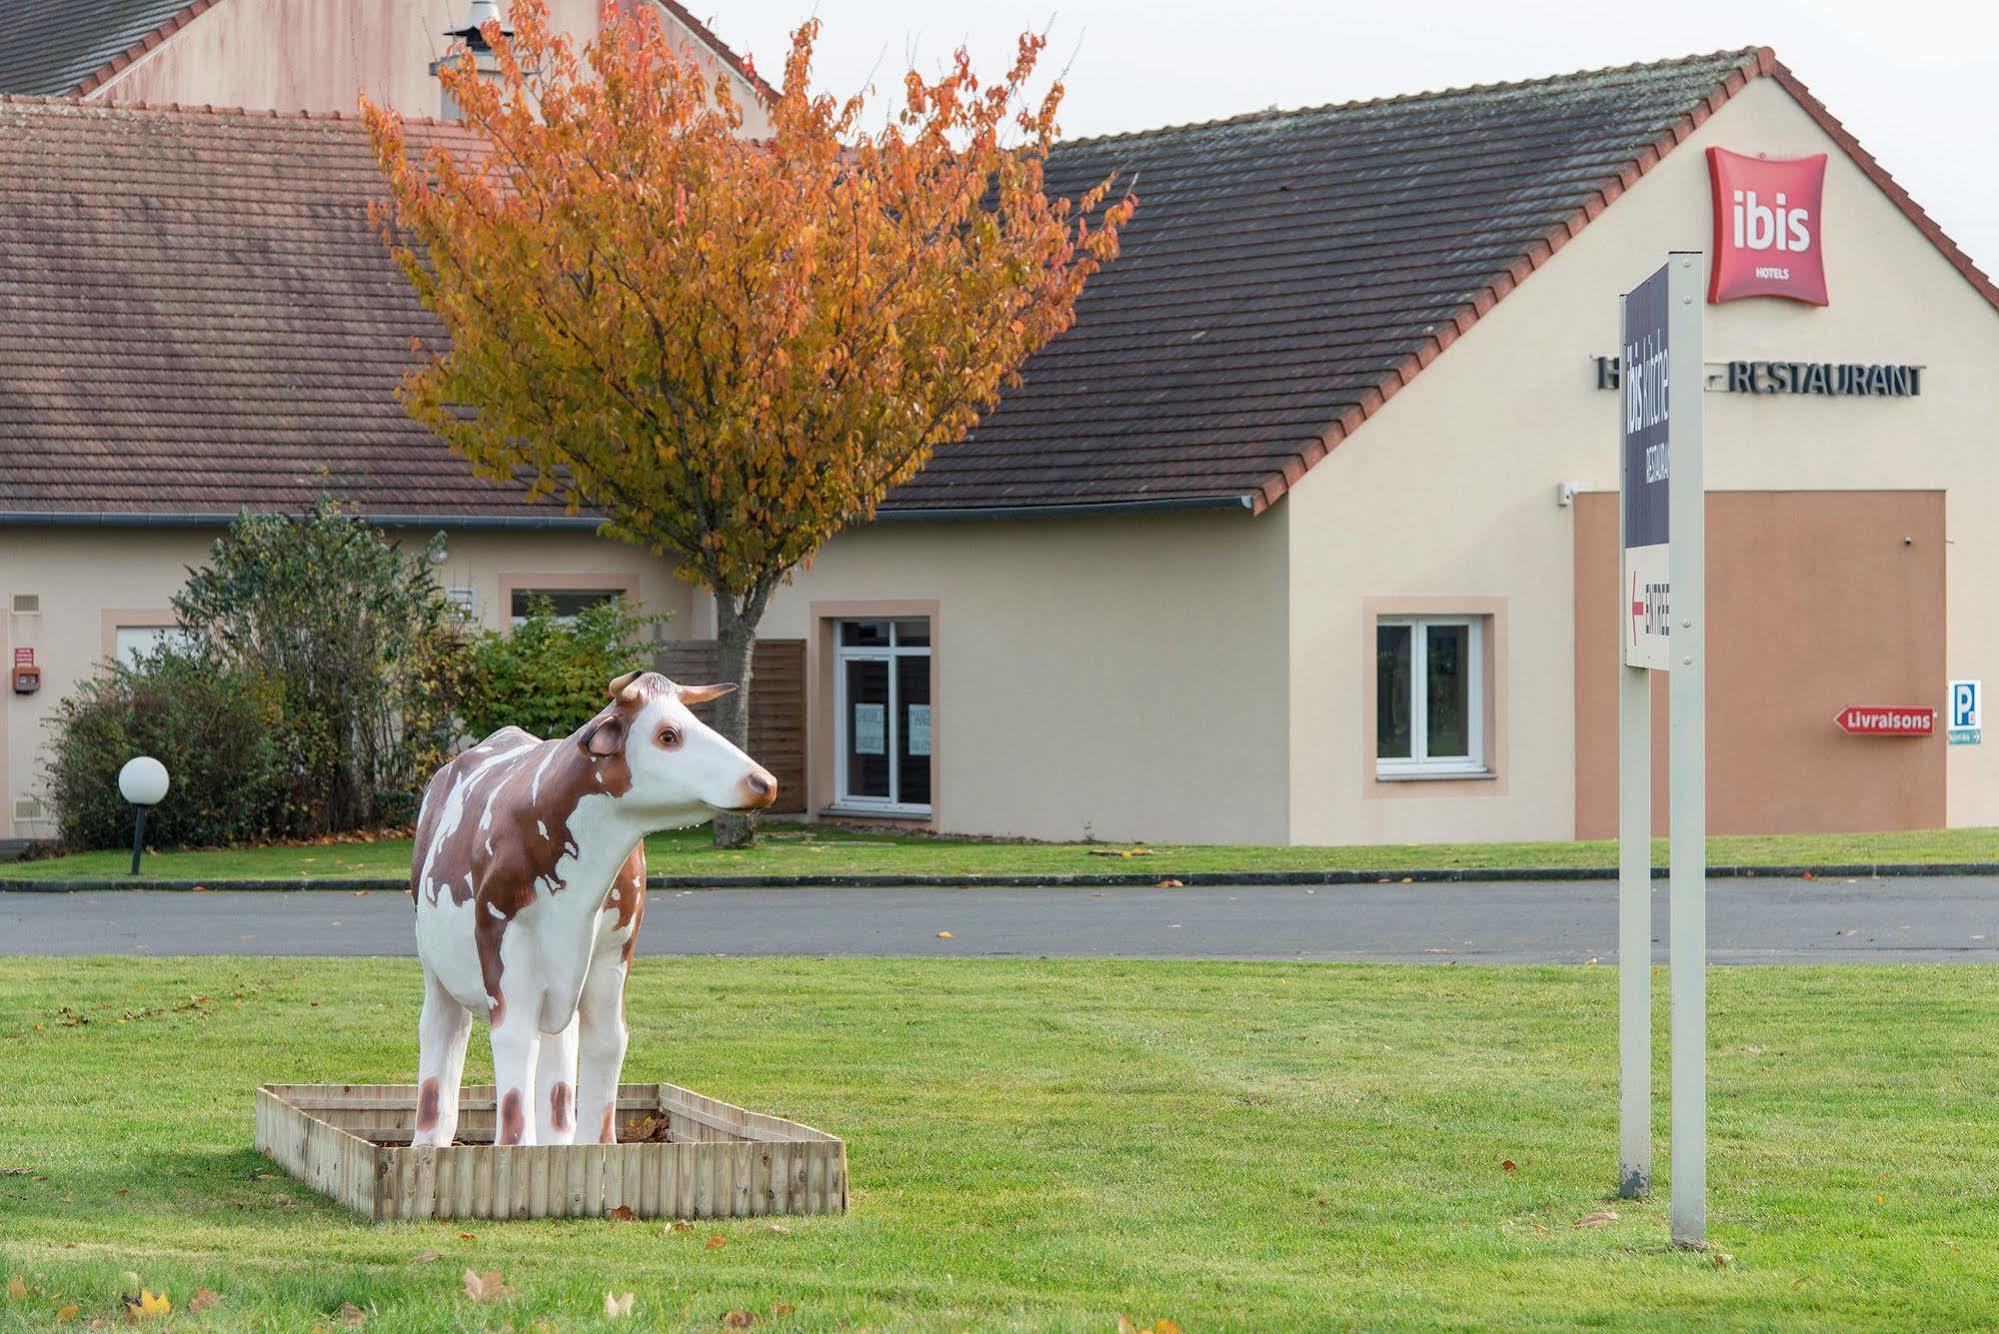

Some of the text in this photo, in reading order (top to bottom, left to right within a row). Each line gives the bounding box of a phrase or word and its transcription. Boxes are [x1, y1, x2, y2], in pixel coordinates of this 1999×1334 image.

[1733, 190, 1811, 253] ibis
[1755, 266, 1790, 280] HOTELS
[1627, 328, 1669, 434] ibis kitche
[1728, 360, 1927, 396] RESTAURANT
[1848, 711, 1931, 730] Livraisons
